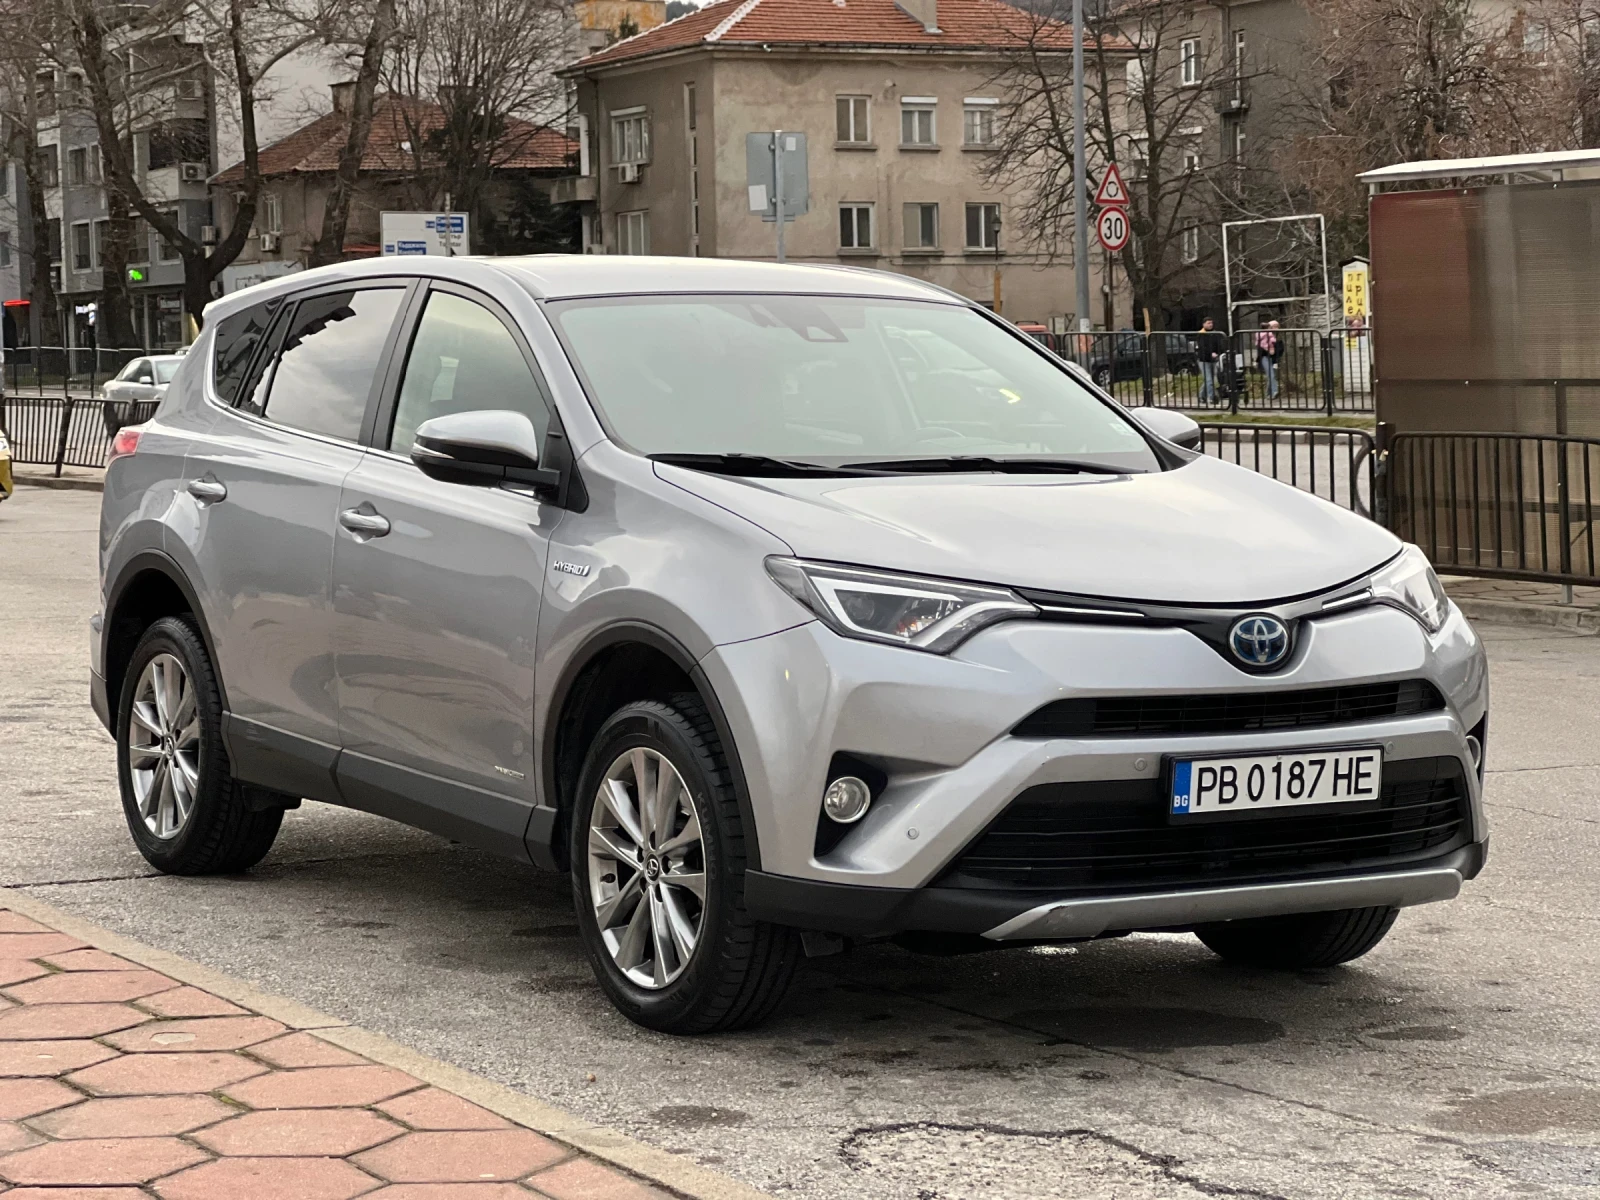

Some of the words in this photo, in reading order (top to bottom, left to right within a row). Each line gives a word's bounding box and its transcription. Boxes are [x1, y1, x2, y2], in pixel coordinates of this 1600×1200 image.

[1104, 217, 1123, 240] 30
[553, 560, 583, 575] HYBRID
[1196, 766, 1238, 806] PB
[1247, 759, 1326, 802] 0187
[1332, 756, 1374, 797] HE
[1174, 795, 1188, 808] BG
